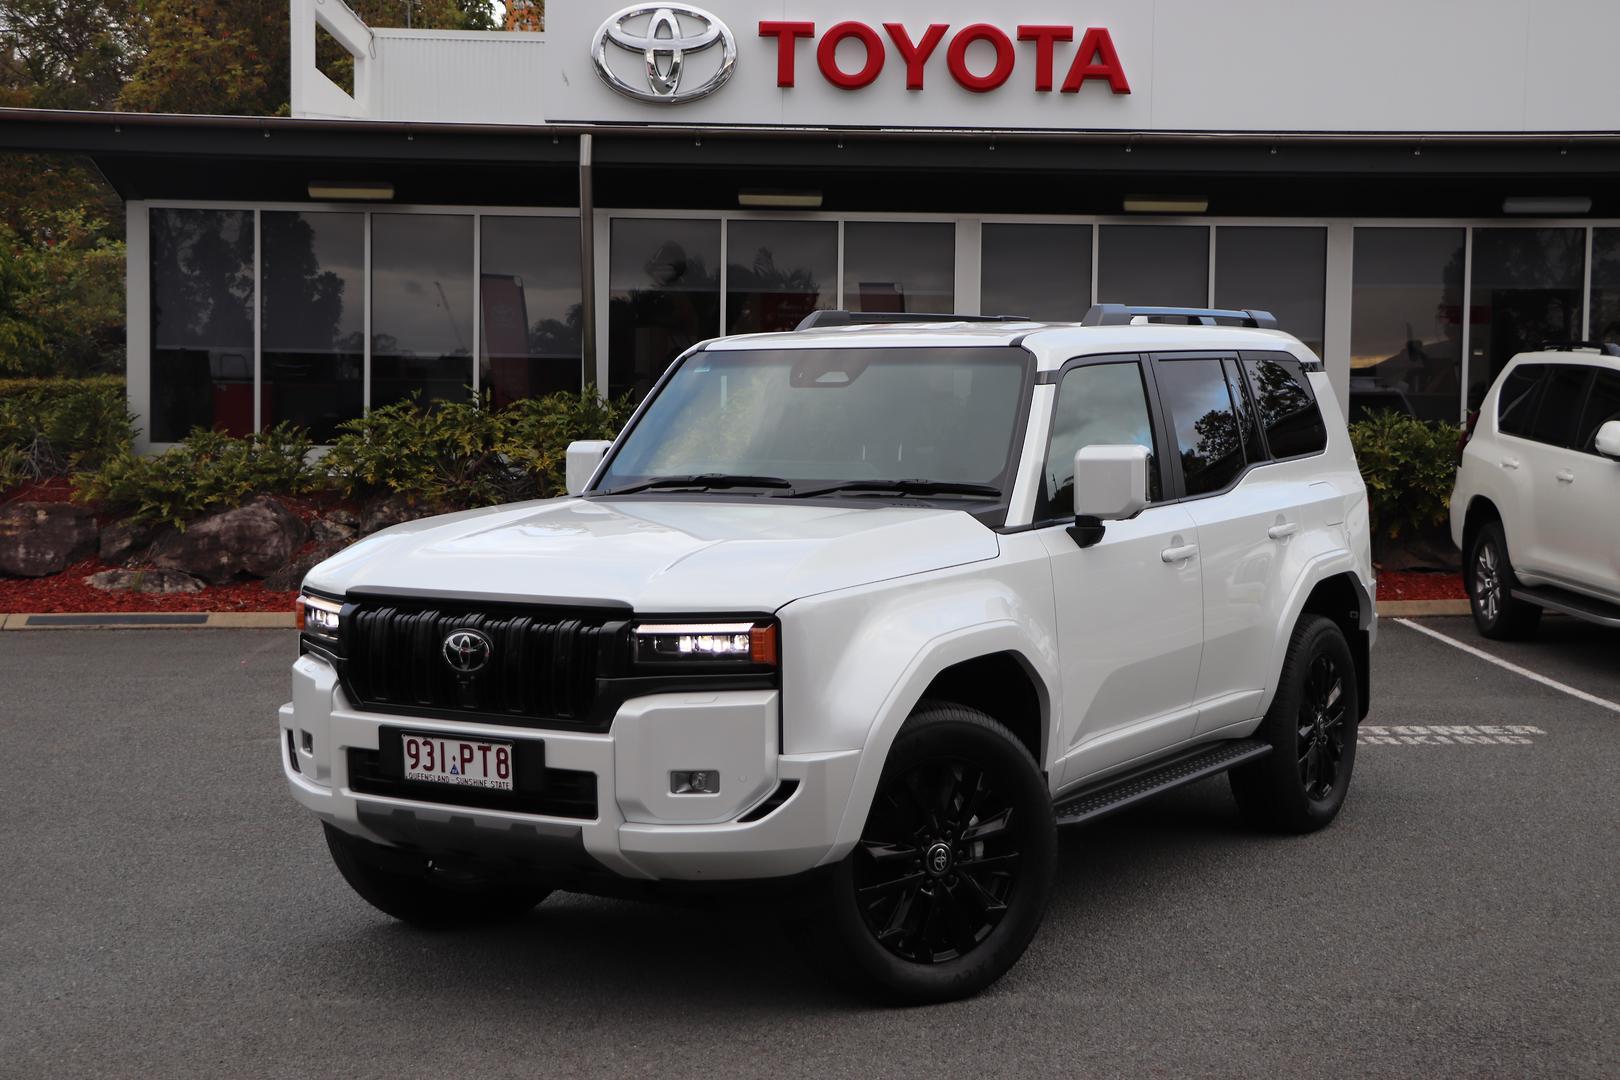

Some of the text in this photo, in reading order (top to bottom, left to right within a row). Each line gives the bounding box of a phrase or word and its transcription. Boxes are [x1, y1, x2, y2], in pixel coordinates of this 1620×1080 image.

[758, 21, 1132, 95] TOYOTA
[456, 776, 487, 787] SUNSHINE
[490, 780, 510, 790] STATE
